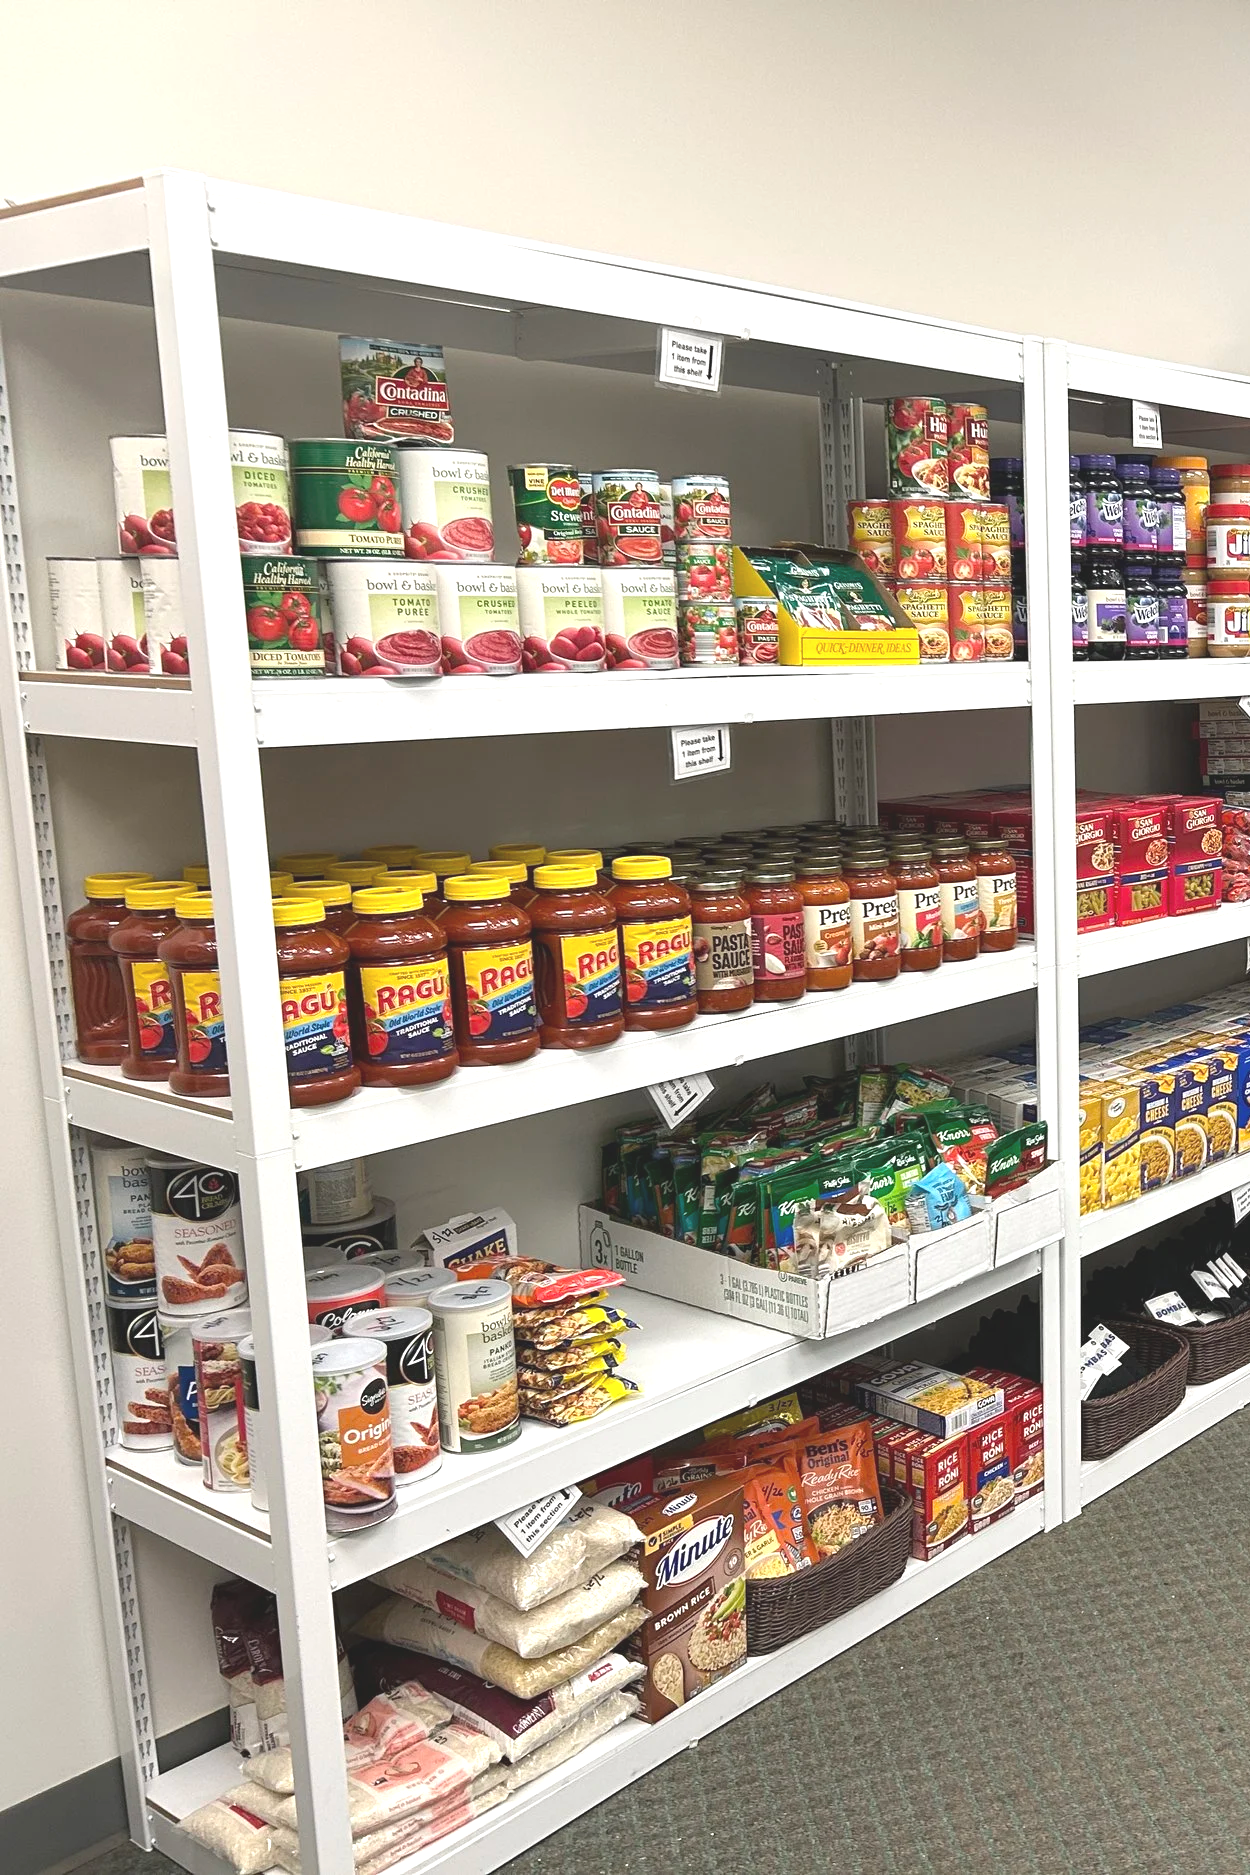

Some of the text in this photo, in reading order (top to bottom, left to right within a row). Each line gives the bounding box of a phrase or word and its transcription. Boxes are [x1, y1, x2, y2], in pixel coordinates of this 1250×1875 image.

[672, 340, 707, 355] Please take
[677, 354, 706, 366] item from
[674, 365, 703, 377] this shelf
[380, 382, 446, 403] Contadina
[390, 407, 438, 419] CRUSHED
[355, 446, 391, 459] California
[346, 457, 375, 470] Healthy
[244, 471, 275, 481] DICED
[432, 467, 473, 480] bowl &
[453, 485, 488, 496] CRUSHED
[551, 486, 564, 496] Del
[625, 526, 656, 534] SAUCE
[253, 573, 286, 587] Healthy
[367, 579, 412, 592] bowl &
[457, 581, 498, 593] bowl &
[542, 582, 582, 594] bowl &
[621, 583, 660, 594] bowl &
[393, 598, 431, 607] TOMATO
[477, 600, 516, 608] CRUSHED
[565, 600, 597, 608] PEELED
[646, 608, 671, 616] SAUCE
[816, 642, 912, 654] QUICK-DINNER IDEAS
[253, 652, 321, 662] DICED TOMATOES
[681, 738, 701, 747] Please
[685, 756, 713, 768] this shelf
[1194, 809, 1207, 819] SAN
[1080, 824, 1094, 832] SAN
[1139, 818, 1153, 828] SAN
[1186, 815, 1214, 829] GIORGIO
[1132, 824, 1160, 840] GIORGIO
[712, 933, 749, 952] PASTA
[712, 949, 750, 970] SAUCE
[713, 970, 729, 979] WITH
[389, 1005, 441, 1028] Old World Style
[510, 1005, 527, 1017] SAUCE
[311, 1020, 331, 1034] Style
[396, 1017, 439, 1036] TRADITIONAL
[408, 1026, 430, 1039] SAUCE
[292, 1043, 317, 1056] SAUCE
[1211, 1081, 1232, 1098] CHEESE
[1182, 1093, 1203, 1111] CHEESE
[1146, 1104, 1169, 1123] CHEESE
[936, 1129, 970, 1143] Knorr
[990, 1155, 1020, 1175] Knorr
[173, 1172, 225, 1218] 4C
[174, 1219, 237, 1239] SEASONED
[619, 1246, 644, 1263] GALLON
[615, 1259, 638, 1274] BOTTLE
[788, 1274, 808, 1285] PAREVE
[731, 1276, 808, 1309] GAL PLASTIC BOTTLES
[1156, 1301, 1187, 1319] BOMBAS
[870, 1364, 918, 1386] GOYA
[768, 1400, 793, 1412] 3/27
[1023, 1404, 1042, 1422] RICE
[982, 1427, 1003, 1447] RICE
[358, 1443, 378, 1455] BREAD
[805, 1438, 848, 1457] Ben's
[807, 1452, 850, 1469] Original
[938, 1451, 958, 1472] RICE
[801, 1464, 860, 1487] Ready Rice
[983, 1462, 1003, 1477] CHICKEN
[762, 1482, 783, 1497] 4/26
[811, 1486, 840, 1497] CHICKEN
[824, 1487, 864, 1501] GRAIN BROWN
[665, 1493, 695, 1516] Minute
[514, 1504, 536, 1528] Please
[526, 1495, 556, 1530] item from
[526, 1502, 563, 1543] this section
[663, 1522, 682, 1537] SIMPLE
[757, 1537, 774, 1552] GARLIC
[656, 1515, 734, 1591] Minute
[655, 1587, 711, 1631] BROWN RICE
